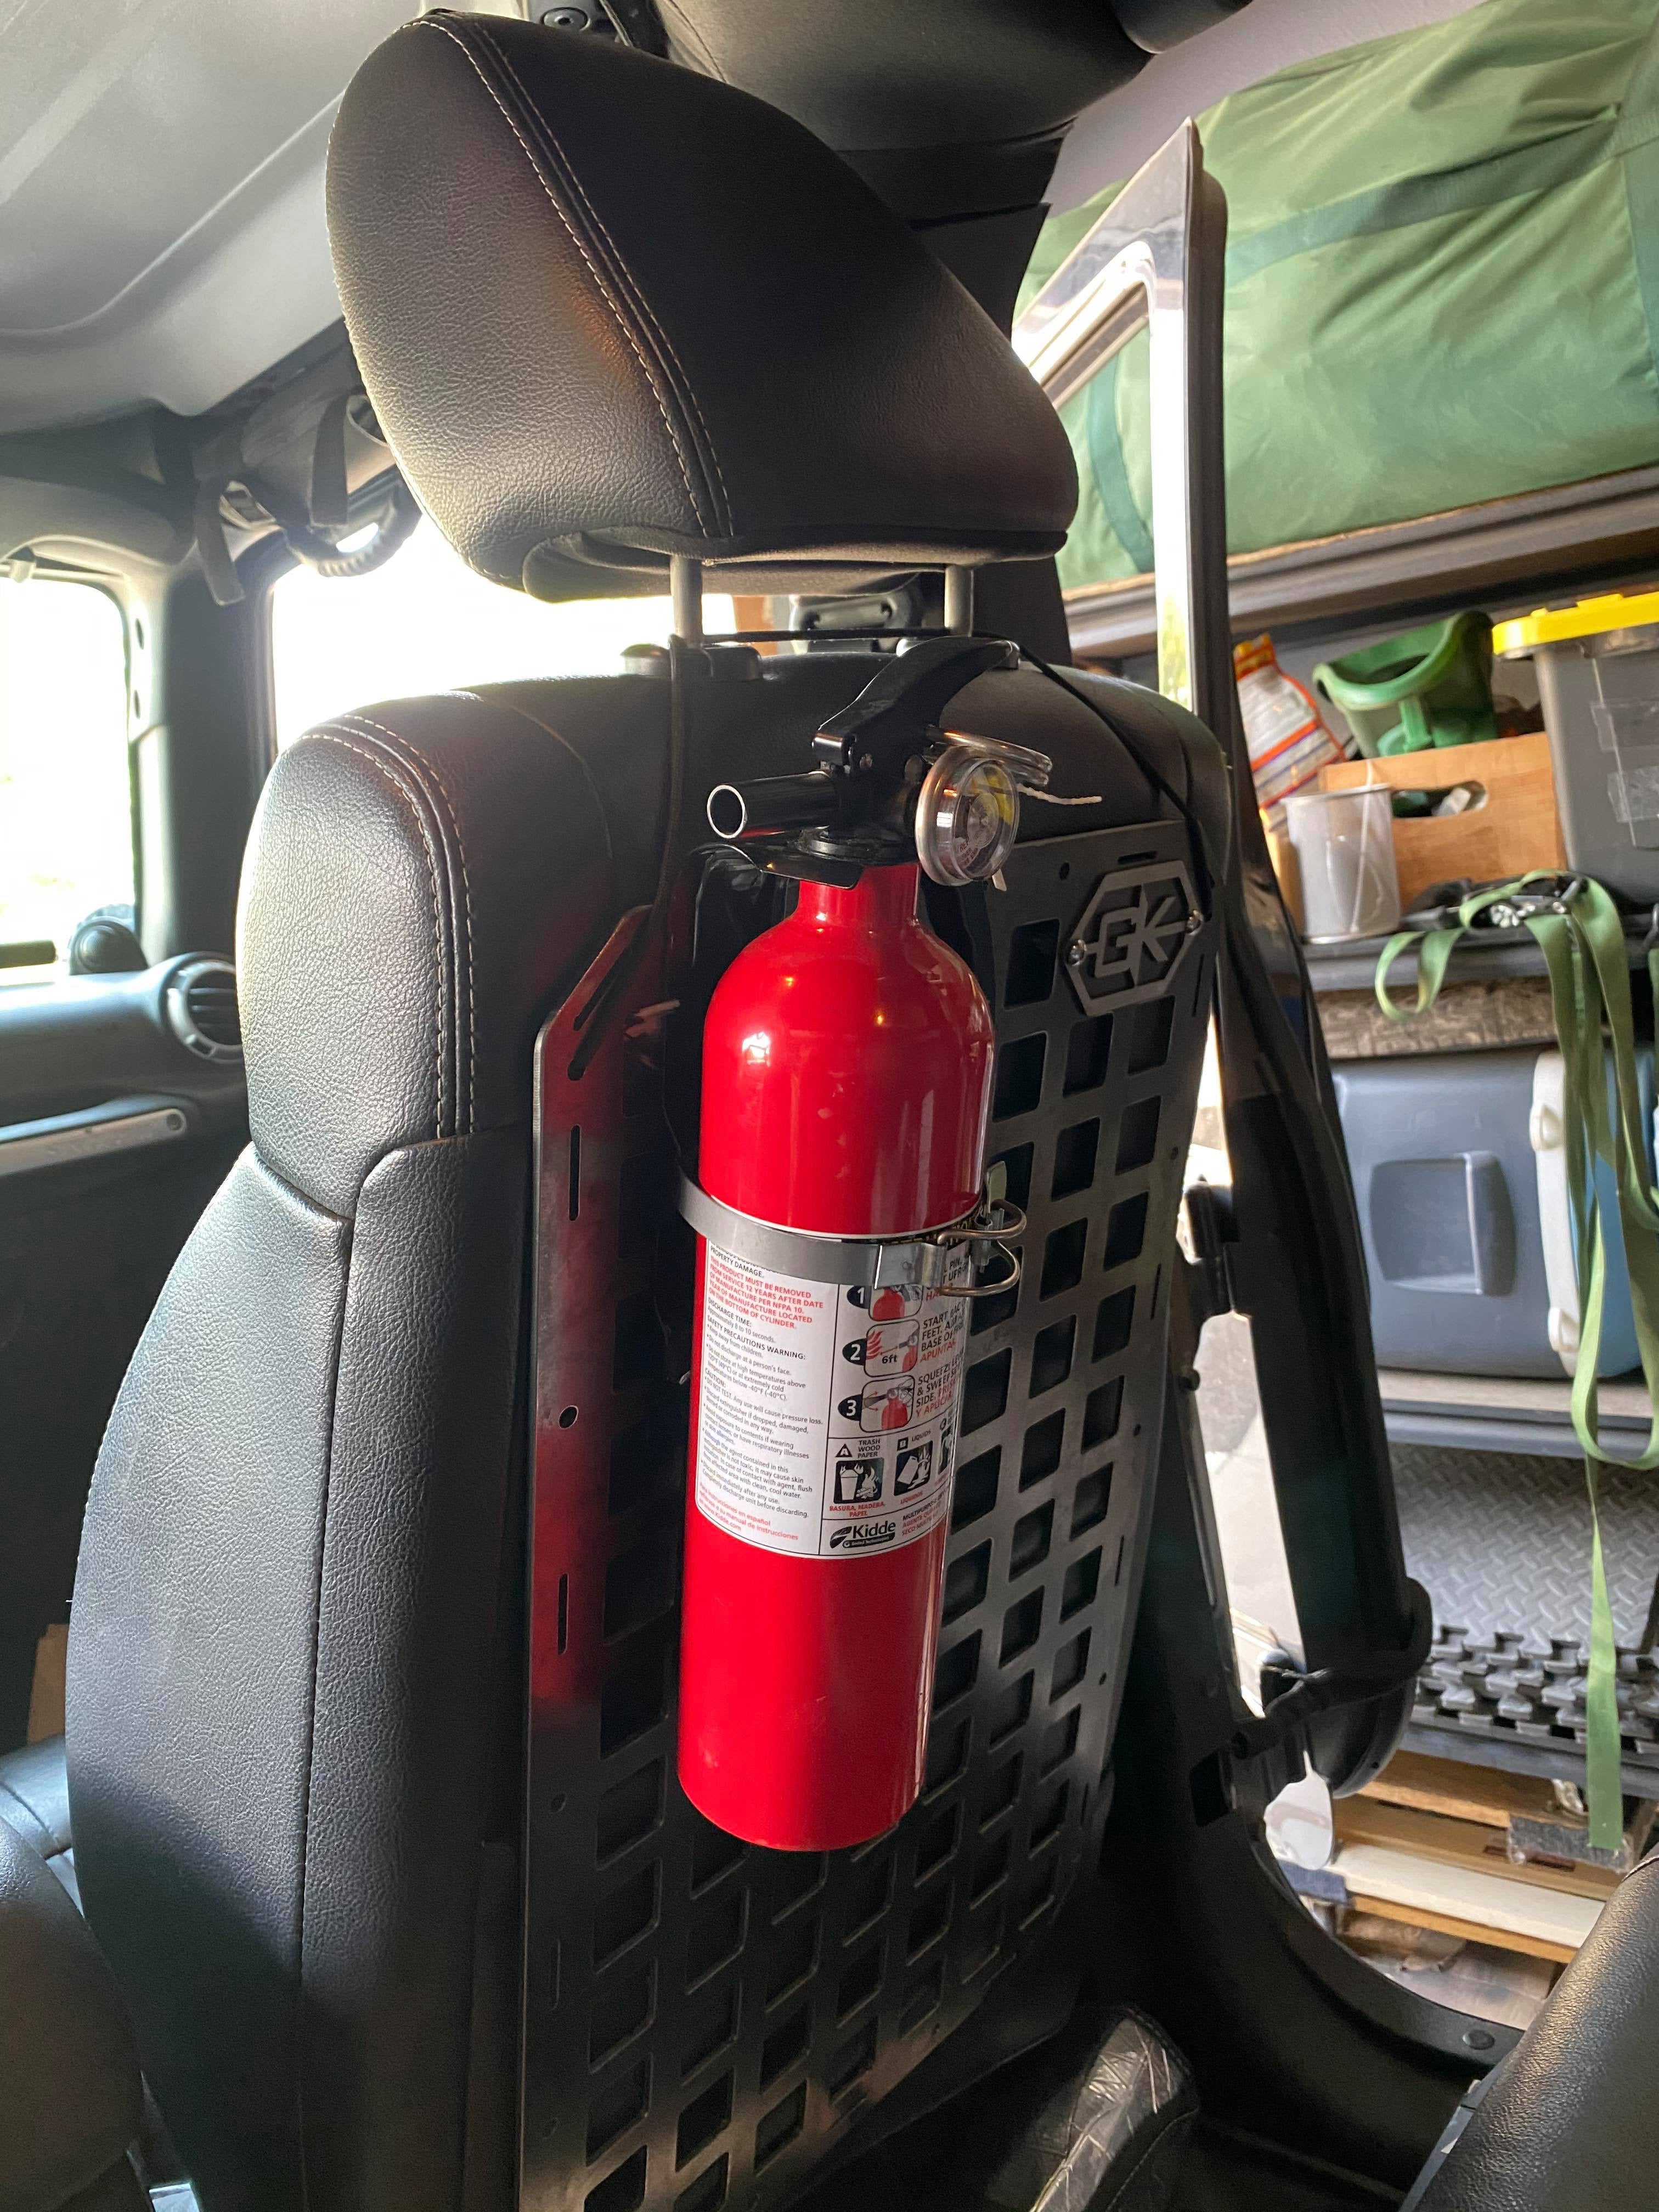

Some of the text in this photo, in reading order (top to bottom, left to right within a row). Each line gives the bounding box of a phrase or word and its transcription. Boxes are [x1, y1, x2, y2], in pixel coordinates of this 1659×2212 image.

[711, 1246, 733, 1267] PROPERTY
[735, 1262, 764, 1278] DAMAGE.
[720, 1260, 744, 1279] PRODUCT
[746, 1277, 763, 1286] MUST
[775, 1285, 811, 1298] REMOVED
[723, 1272, 744, 1289] SERVICE
[754, 1285, 776, 1300] YEARS
[778, 1295, 801, 1305] AFTER
[716, 1274, 757, 1301] MANUFACTURE
[759, 1297, 770, 1307] PER
[773, 1302, 791, 1312] NFPA
[857, 1287, 864, 1304] 1
[708, 1297, 752, 1327] DISCHARGE TIME:
[725, 1297, 749, 1315] BOTTOM
[760, 1314, 797, 1329] CYLINDER.
[729, 1292, 776, 1316] MANUFACTURE
[779, 1312, 812, 1323] LOCATED
[923, 1311, 948, 1329] START
[708, 1315, 805, 1360] SAFETY PRECAUTIONS WARNING:
[753, 1330, 776, 1343] seconds.
[922, 1325, 942, 1340] FEET.
[922, 1335, 941, 1351] BASE
[721, 1343, 741, 1361] discharge
[753, 1359, 776, 1373] person's
[778, 1367, 792, 1375] face.
[741, 1344, 763, 1358] children.
[850, 1344, 860, 1361] 2
[882, 1355, 898, 1364] 6ft
[705, 1368, 726, 1388] CAUTION:
[733, 1376, 747, 1389] below
[737, 1363, 748, 1374] high
[749, 1368, 786, 1385] temperatures
[787, 1380, 806, 1389] above
[744, 1375, 770, 1390] extremely
[771, 1383, 784, 1392] cold
[917, 1387, 923, 1396] &
[720, 1397, 747, 1417] extinguisher
[752, 1413, 777, 1428] dropped,
[779, 1422, 809, 1434] damaged,
[721, 1389, 732, 1400] TEST.
[733, 1395, 742, 1406] Any
[754, 1404, 763, 1412] will
[765, 1409, 781, 1418] cause
[782, 1413, 808, 1423] pressure
[809, 1417, 823, 1425] loss.
[846, 1400, 856, 1416] 3
[750, 1420, 759, 1431] any
[760, 1425, 774, 1435] way.
[740, 1434, 751, 1444] have
[752, 1440, 783, 1455] respiratory
[784, 1447, 809, 1459] illnesses
[741, 1428, 764, 1440] contents
[770, 1438, 793, 1449] wearing
[729, 1447, 742, 1459] agent
[743, 1454, 769, 1468] contained
[742, 1469, 765, 1481] contact
[766, 1476, 776, 1485] with
[777, 1481, 796, 1491] agent,
[798, 1485, 812, 1493] flush
[760, 1469, 772, 1478] may
[773, 1472, 789, 1481] cause
[740, 1475, 751, 1486] with
[752, 1480, 768, 1492] clean,
[770, 1486, 781, 1495] cool
[783, 1489, 802, 1499] water.
[743, 1486, 756, 1497] after
[757, 1491, 767, 1502] any
[768, 1496, 780, 1504] use.
[746, 1495, 755, 1505] unit
[757, 1499, 775, 1511] before
[776, 1505, 809, 1519] discarding.
[726, 1511, 746, 1525] manual
[757, 1524, 799, 1541] instrucciones
[747, 1513, 771, 1527] español
[853, 1521, 895, 1538] Kidde
